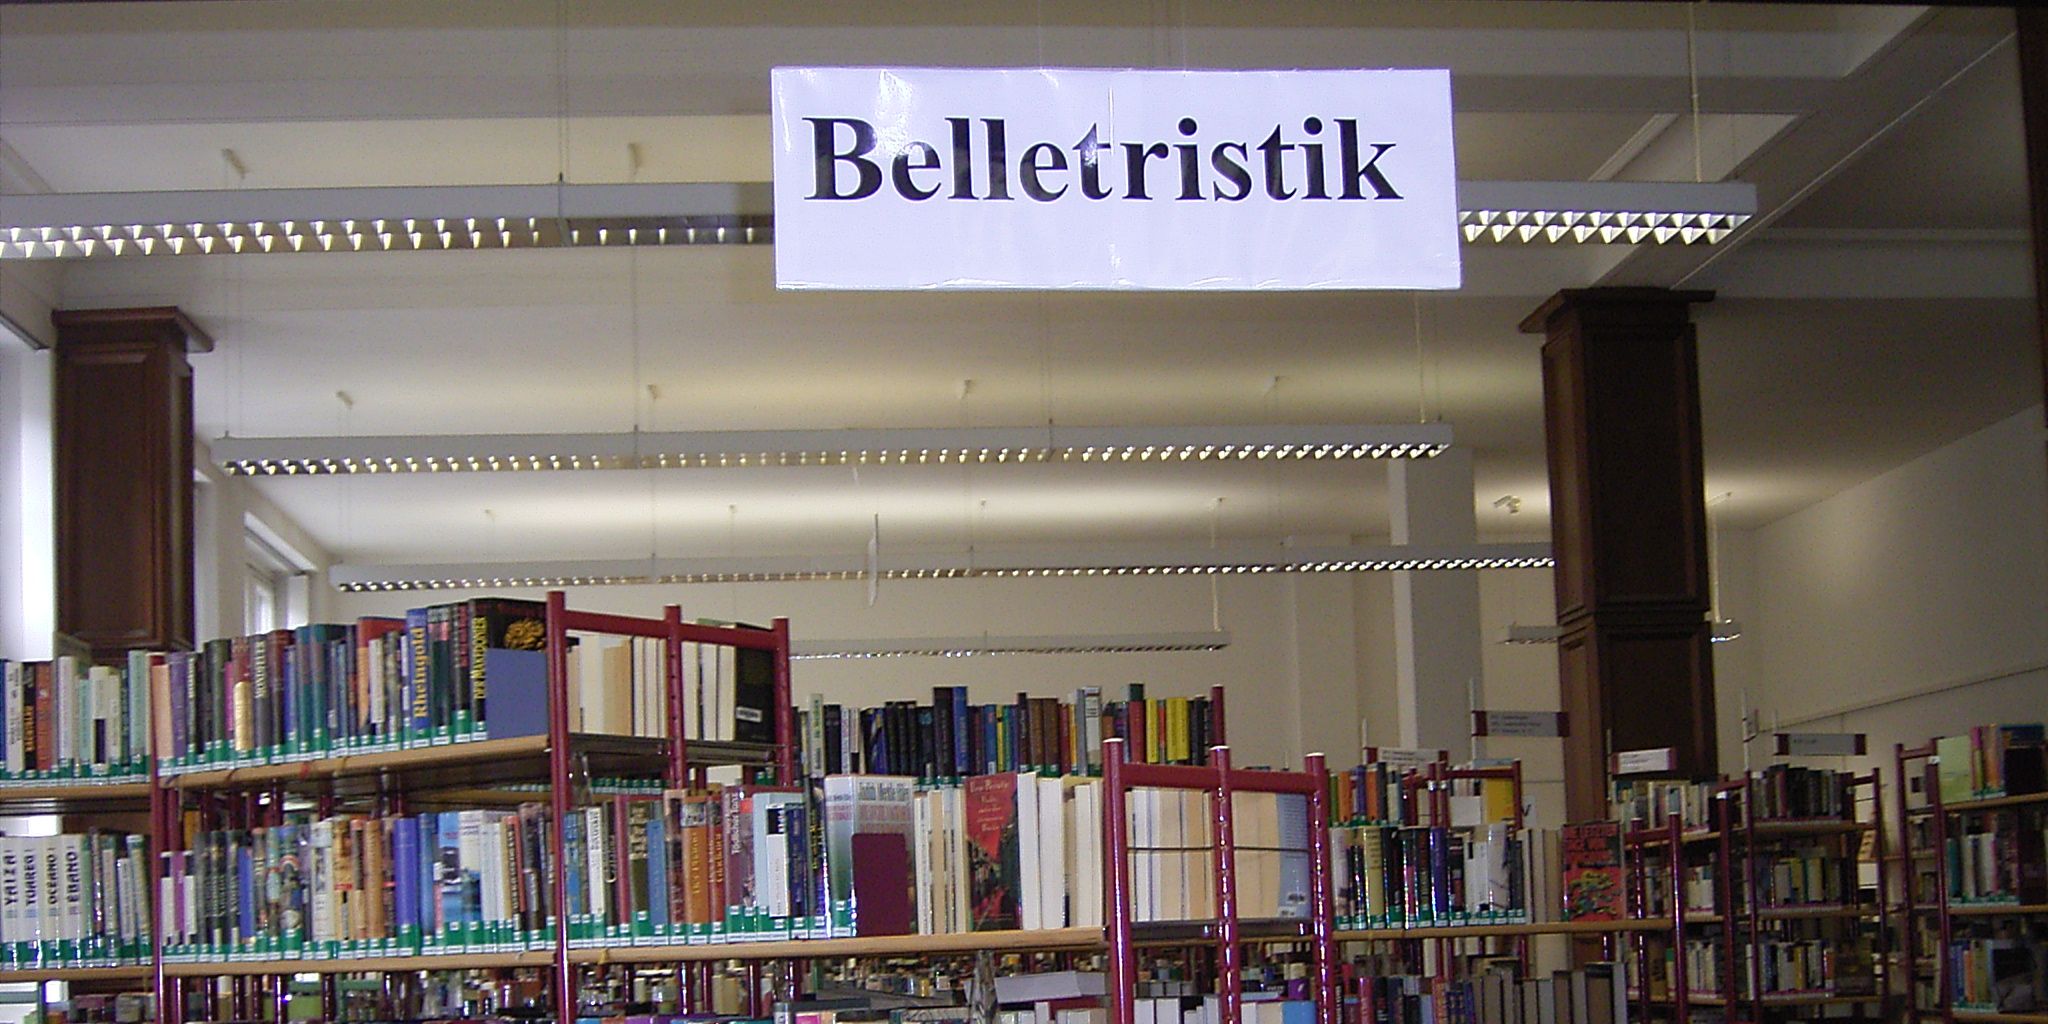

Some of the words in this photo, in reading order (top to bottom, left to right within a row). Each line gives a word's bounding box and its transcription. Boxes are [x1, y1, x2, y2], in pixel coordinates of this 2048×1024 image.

[801, 115, 1404, 202] Belletristik
[411, 627, 431, 718] Rheingold
[3, 854, 18, 906] YAIZA
[23, 854, 36, 907] TUAREG
